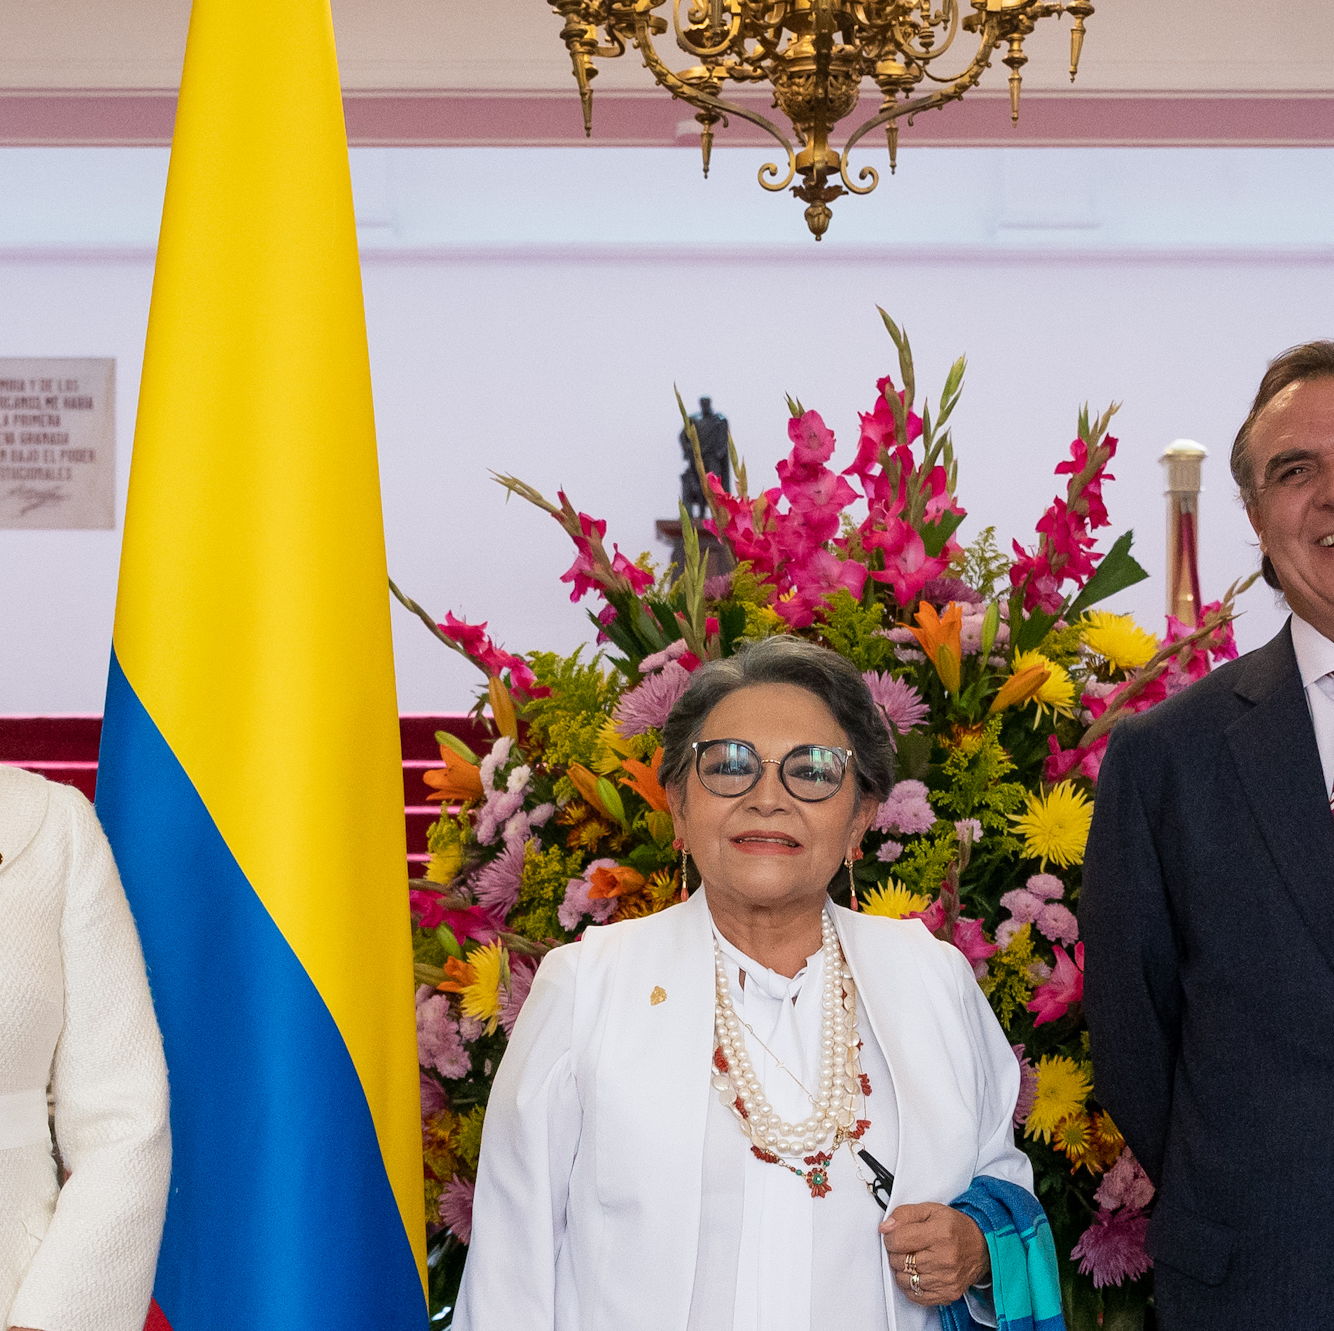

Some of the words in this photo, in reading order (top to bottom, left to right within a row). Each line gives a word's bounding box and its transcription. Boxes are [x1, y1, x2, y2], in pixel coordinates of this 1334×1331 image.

[41, 379, 52, 392] DE
[58, 379, 79, 392] LOS
[45, 396, 58, 410] ME
[13, 413, 60, 427] PRIMERA
[20, 431, 69, 445] GRANADA
[11, 449, 40, 463] BAJO
[44, 449, 56, 463] EL
[60, 449, 96, 463] PODER
